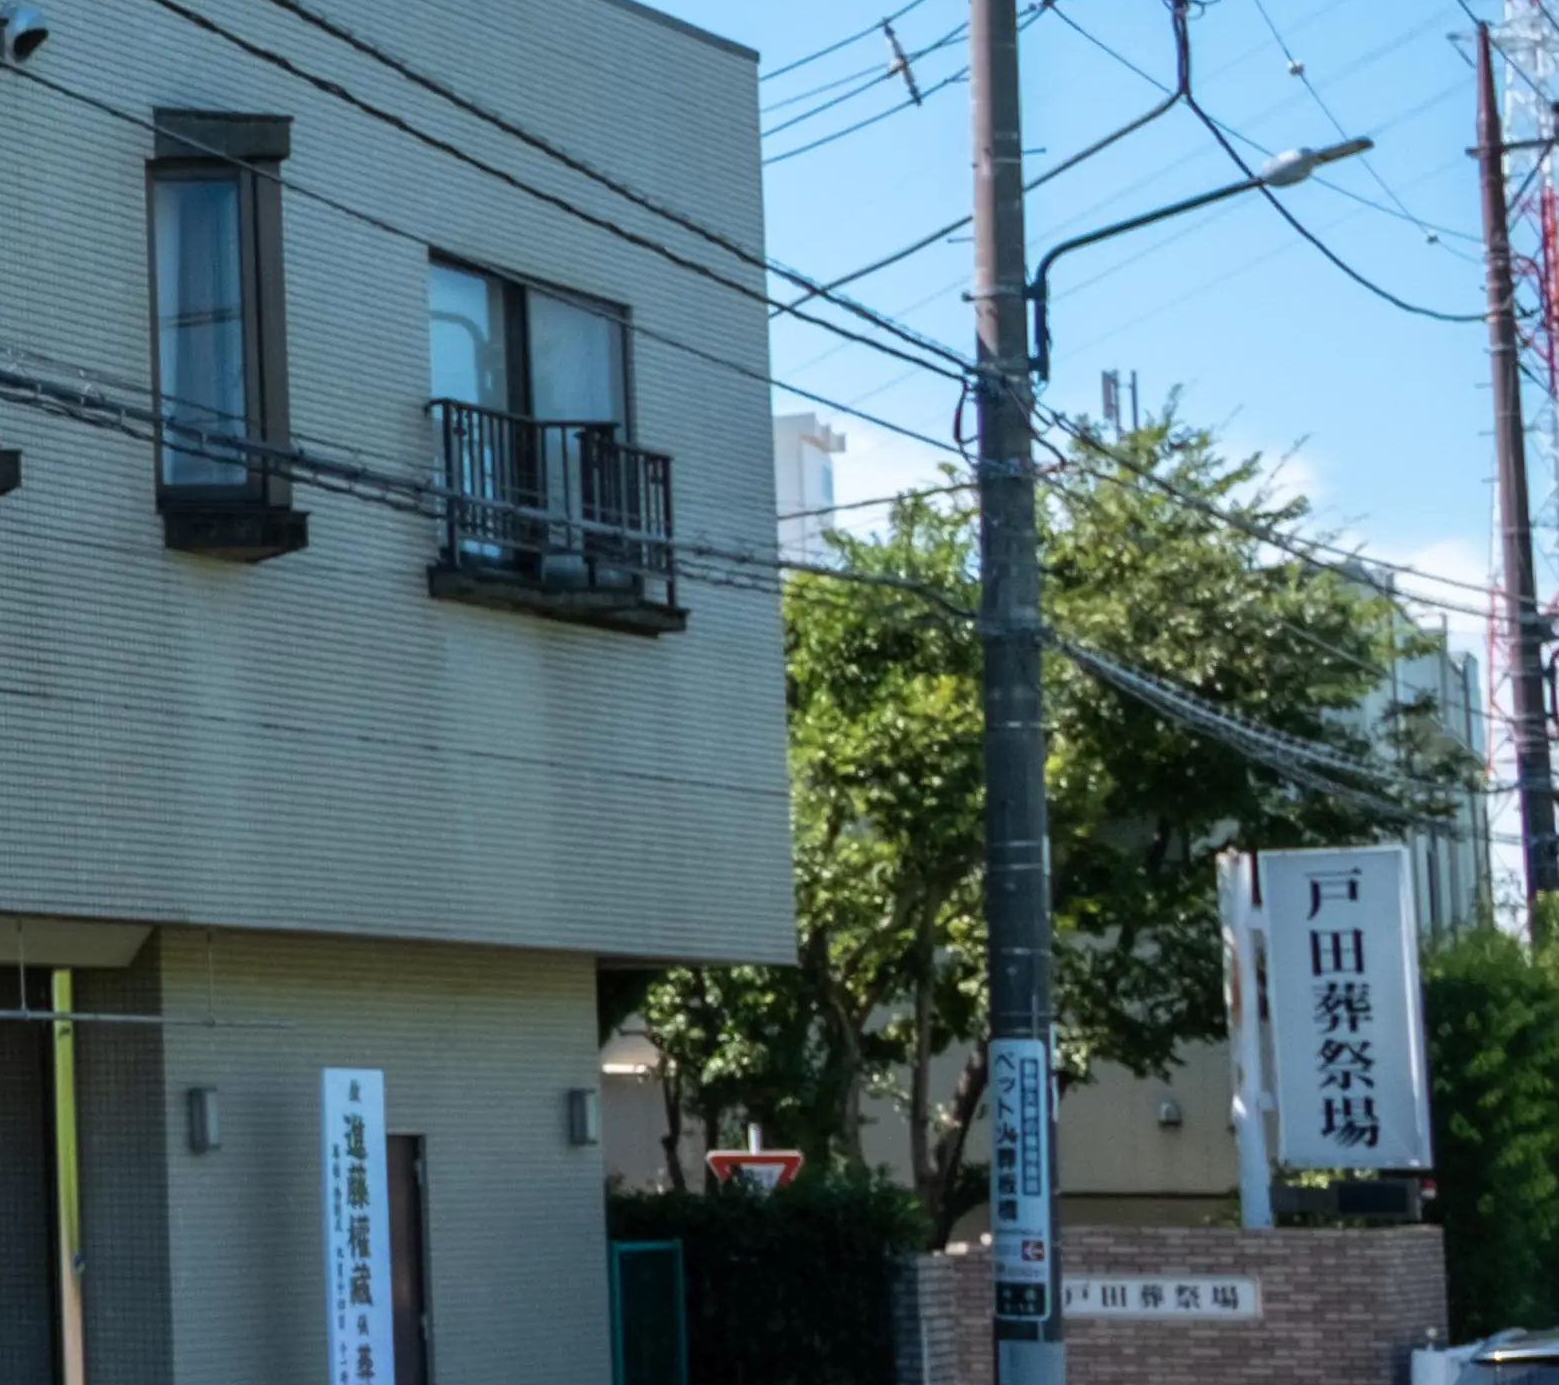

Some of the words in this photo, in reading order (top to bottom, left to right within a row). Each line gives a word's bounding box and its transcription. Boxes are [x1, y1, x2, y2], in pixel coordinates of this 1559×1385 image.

[1305, 866, 1381, 1149] 戸田葬祭場
